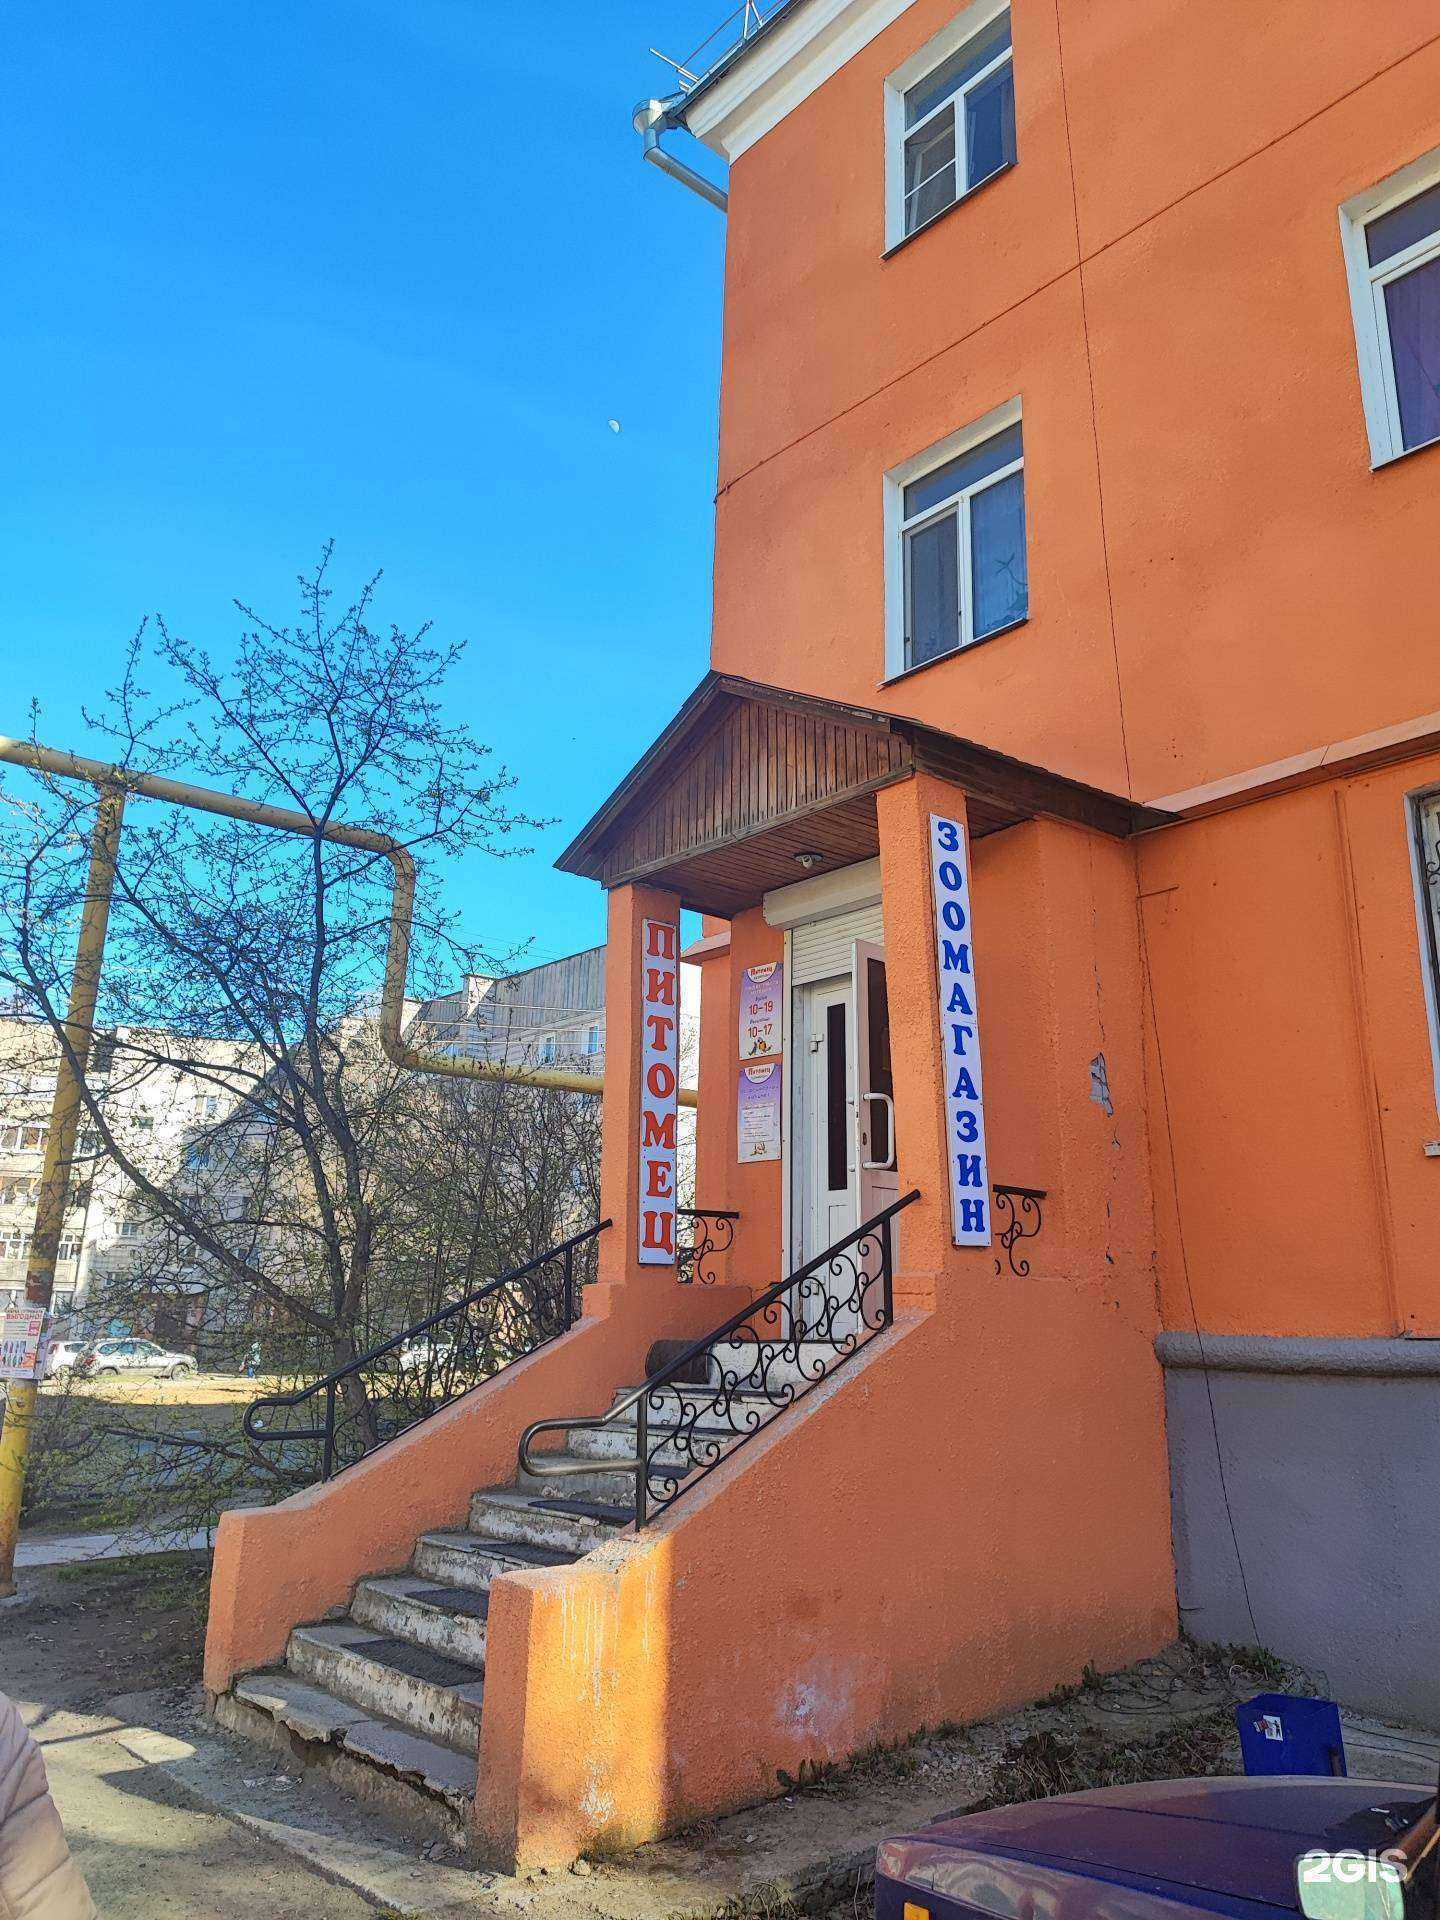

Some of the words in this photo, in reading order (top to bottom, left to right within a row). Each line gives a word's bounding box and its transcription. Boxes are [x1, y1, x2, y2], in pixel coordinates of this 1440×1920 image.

[642, 922, 675, 1255] ПИТОМЕЦ
[747, 1023, 772, 1038] 10-17
[937, 820, 986, 1233] ЗООМАГАЗИН
